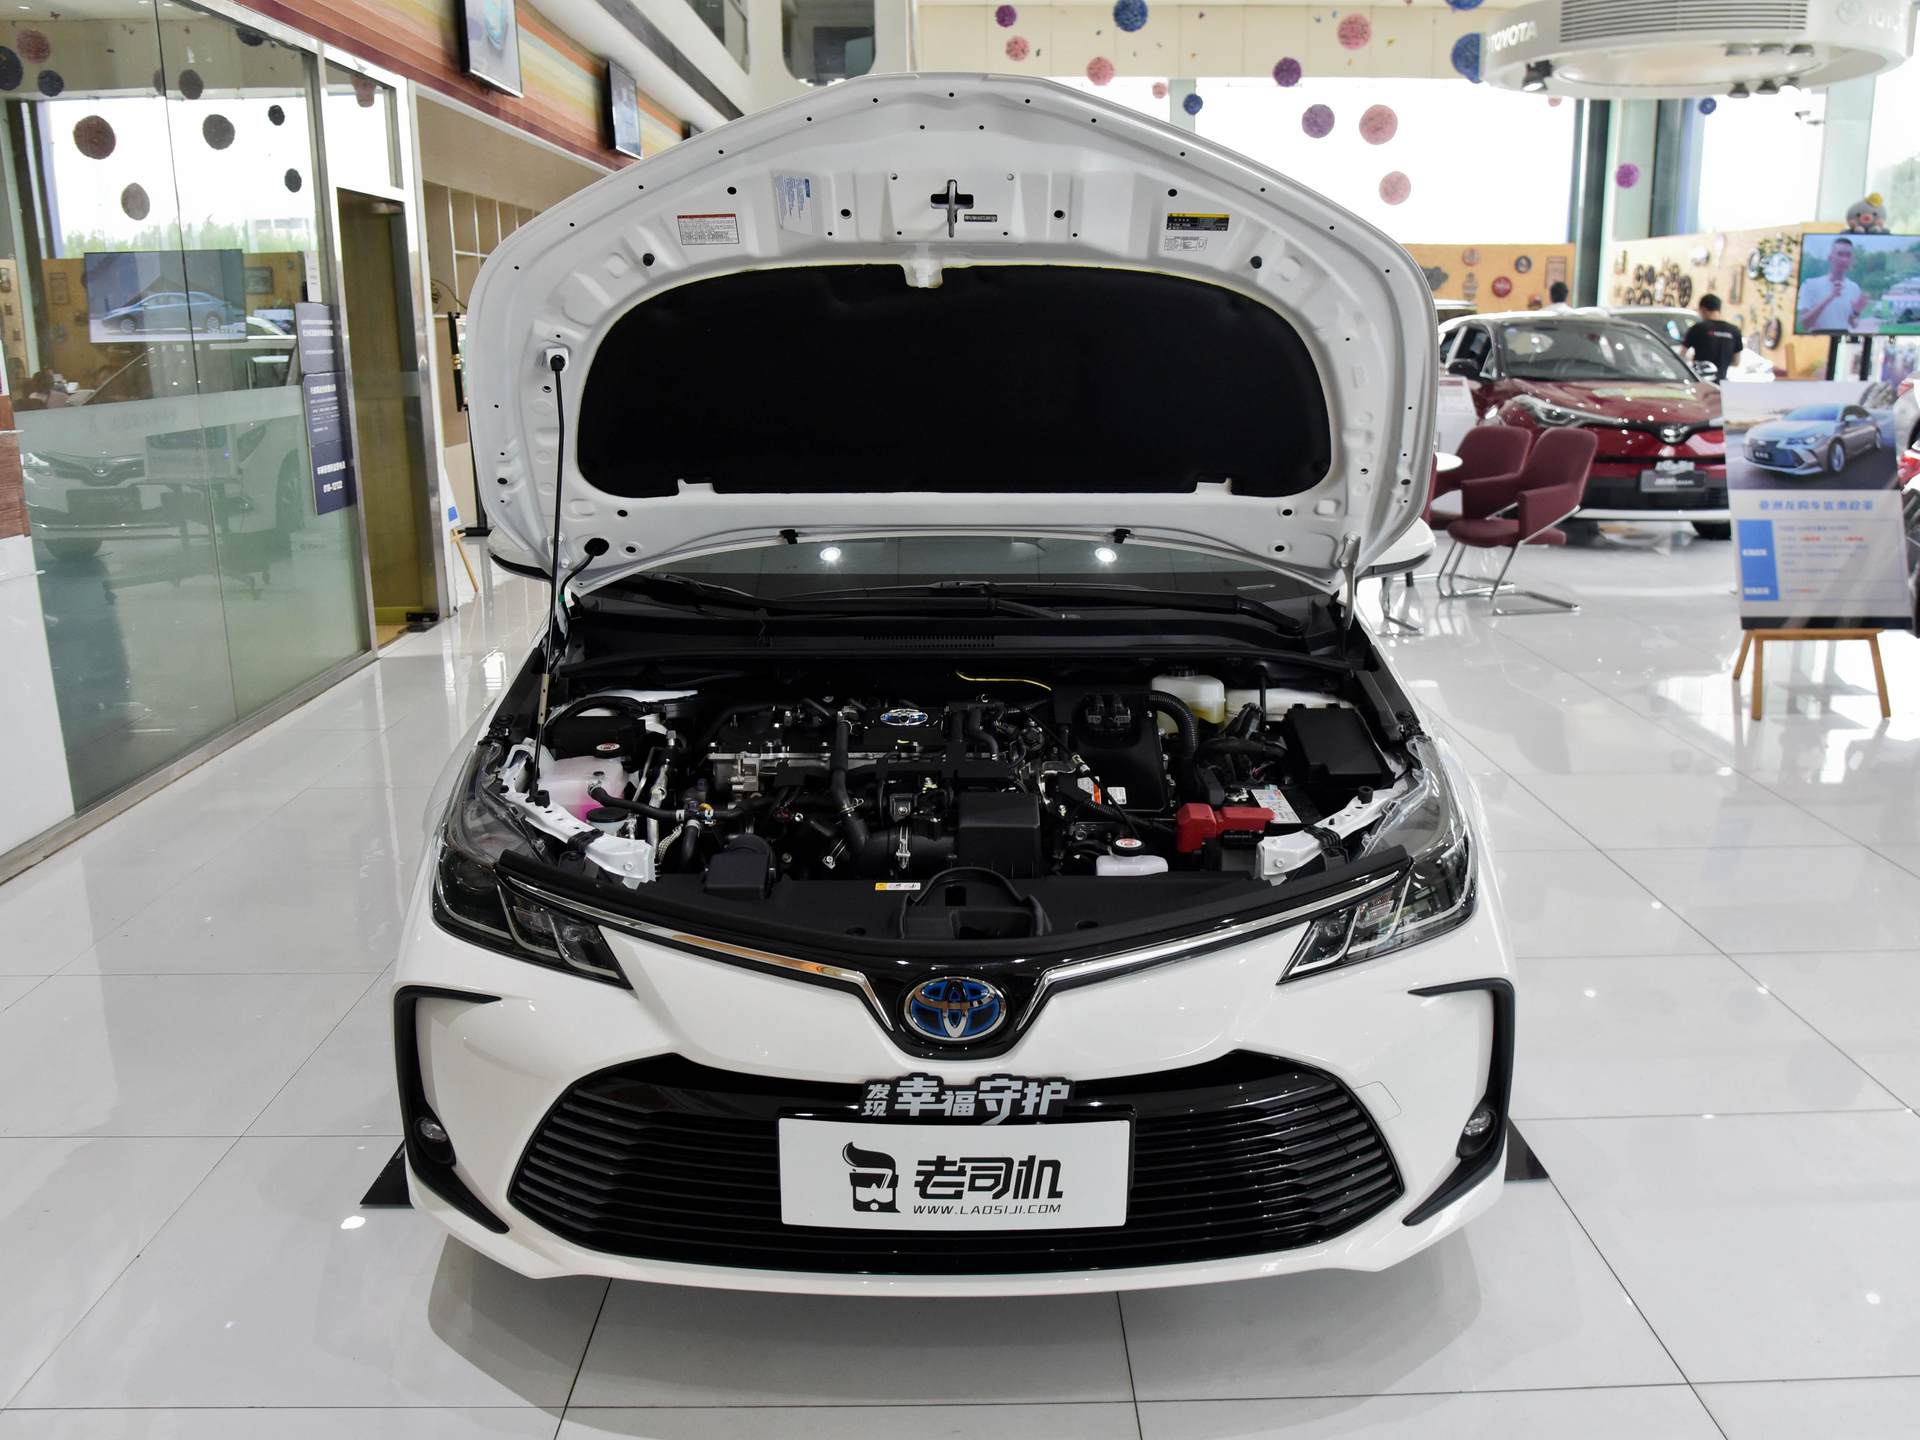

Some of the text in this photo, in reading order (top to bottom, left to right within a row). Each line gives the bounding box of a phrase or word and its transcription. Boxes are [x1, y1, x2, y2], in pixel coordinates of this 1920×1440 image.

[1489, 21, 1537, 52] TOYOTA
[861, 1083, 891, 1117] 发现
[894, 1077, 1070, 1125] 幸福守护
[914, 1155, 1063, 1199] 老司机
[913, 1204, 1061, 1215] WWW.LAOSIJI.COM
